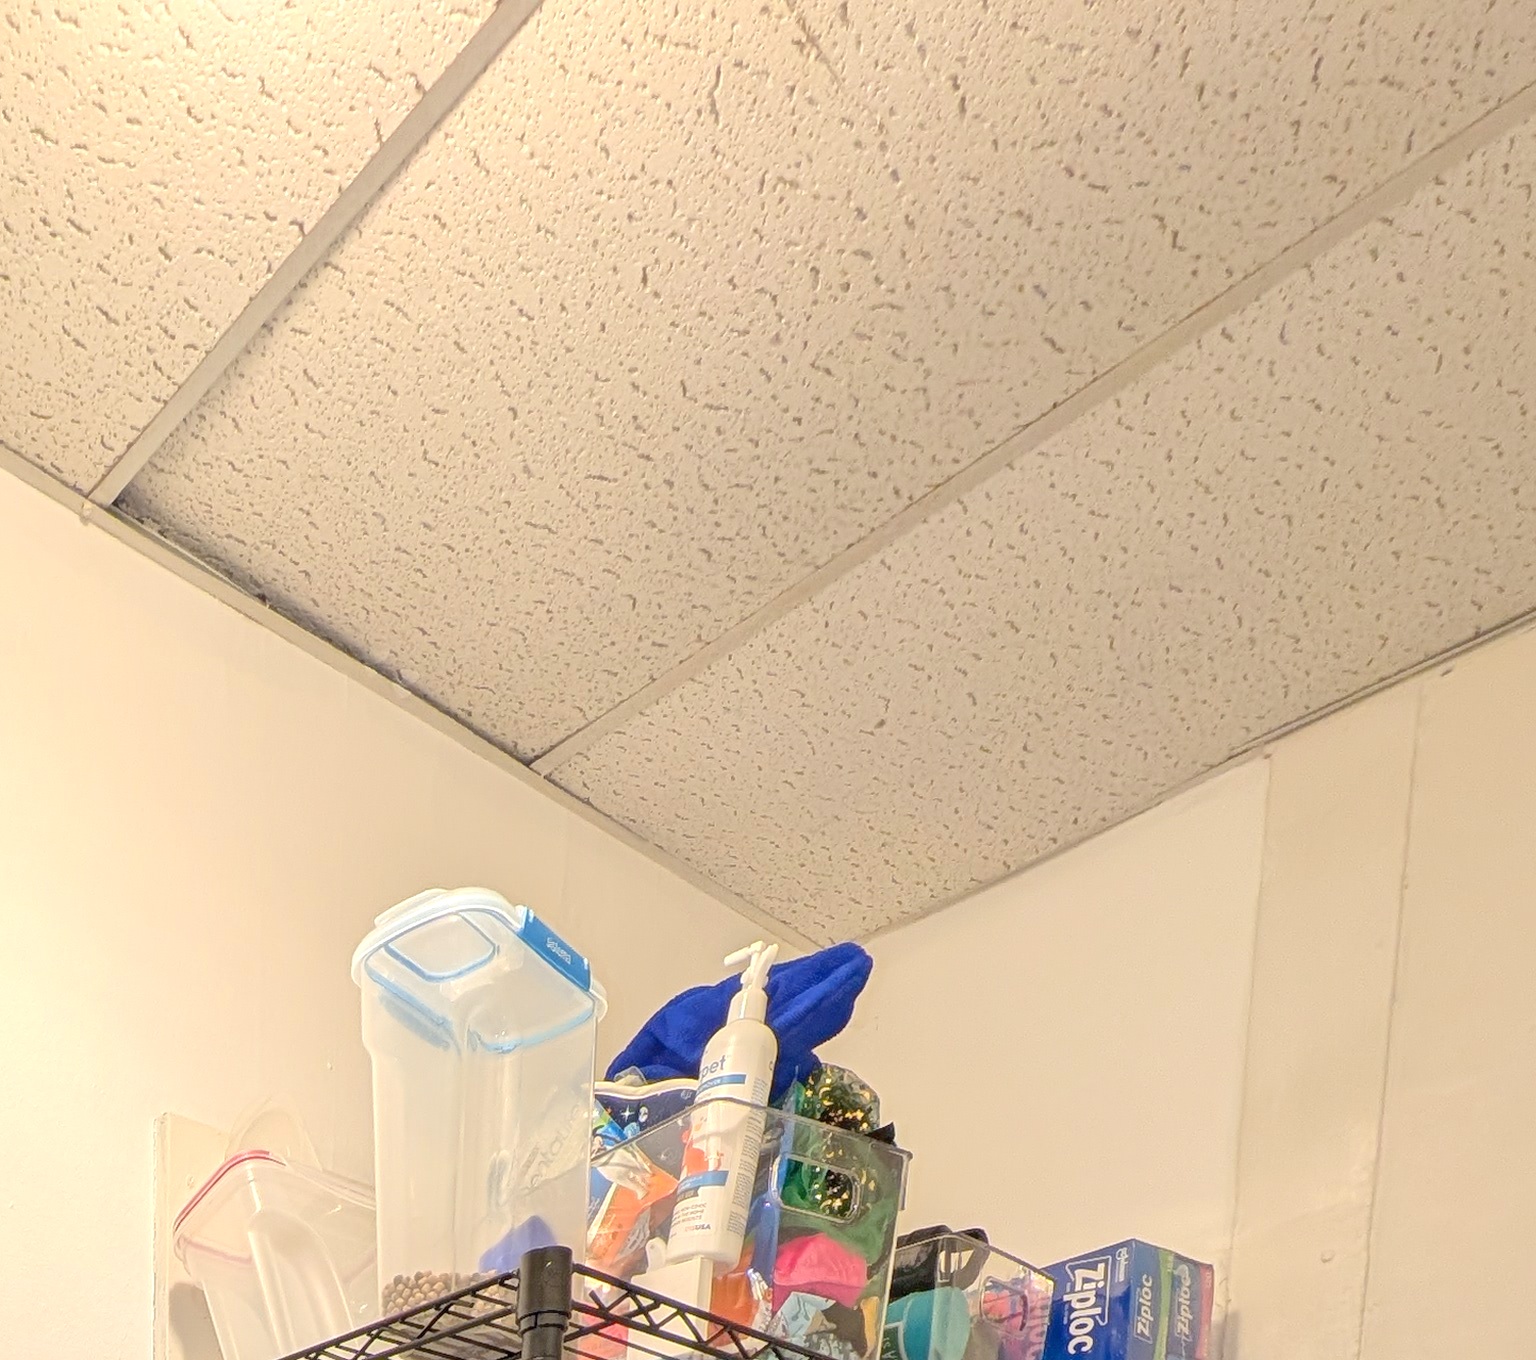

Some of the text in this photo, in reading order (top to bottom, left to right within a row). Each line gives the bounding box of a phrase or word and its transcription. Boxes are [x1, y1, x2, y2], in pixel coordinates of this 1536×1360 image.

[1063, 1263, 1106, 1355] Ziploc
[1136, 1273, 1153, 1340] Ziploc
[1175, 1271, 1192, 1340] Ziploc
